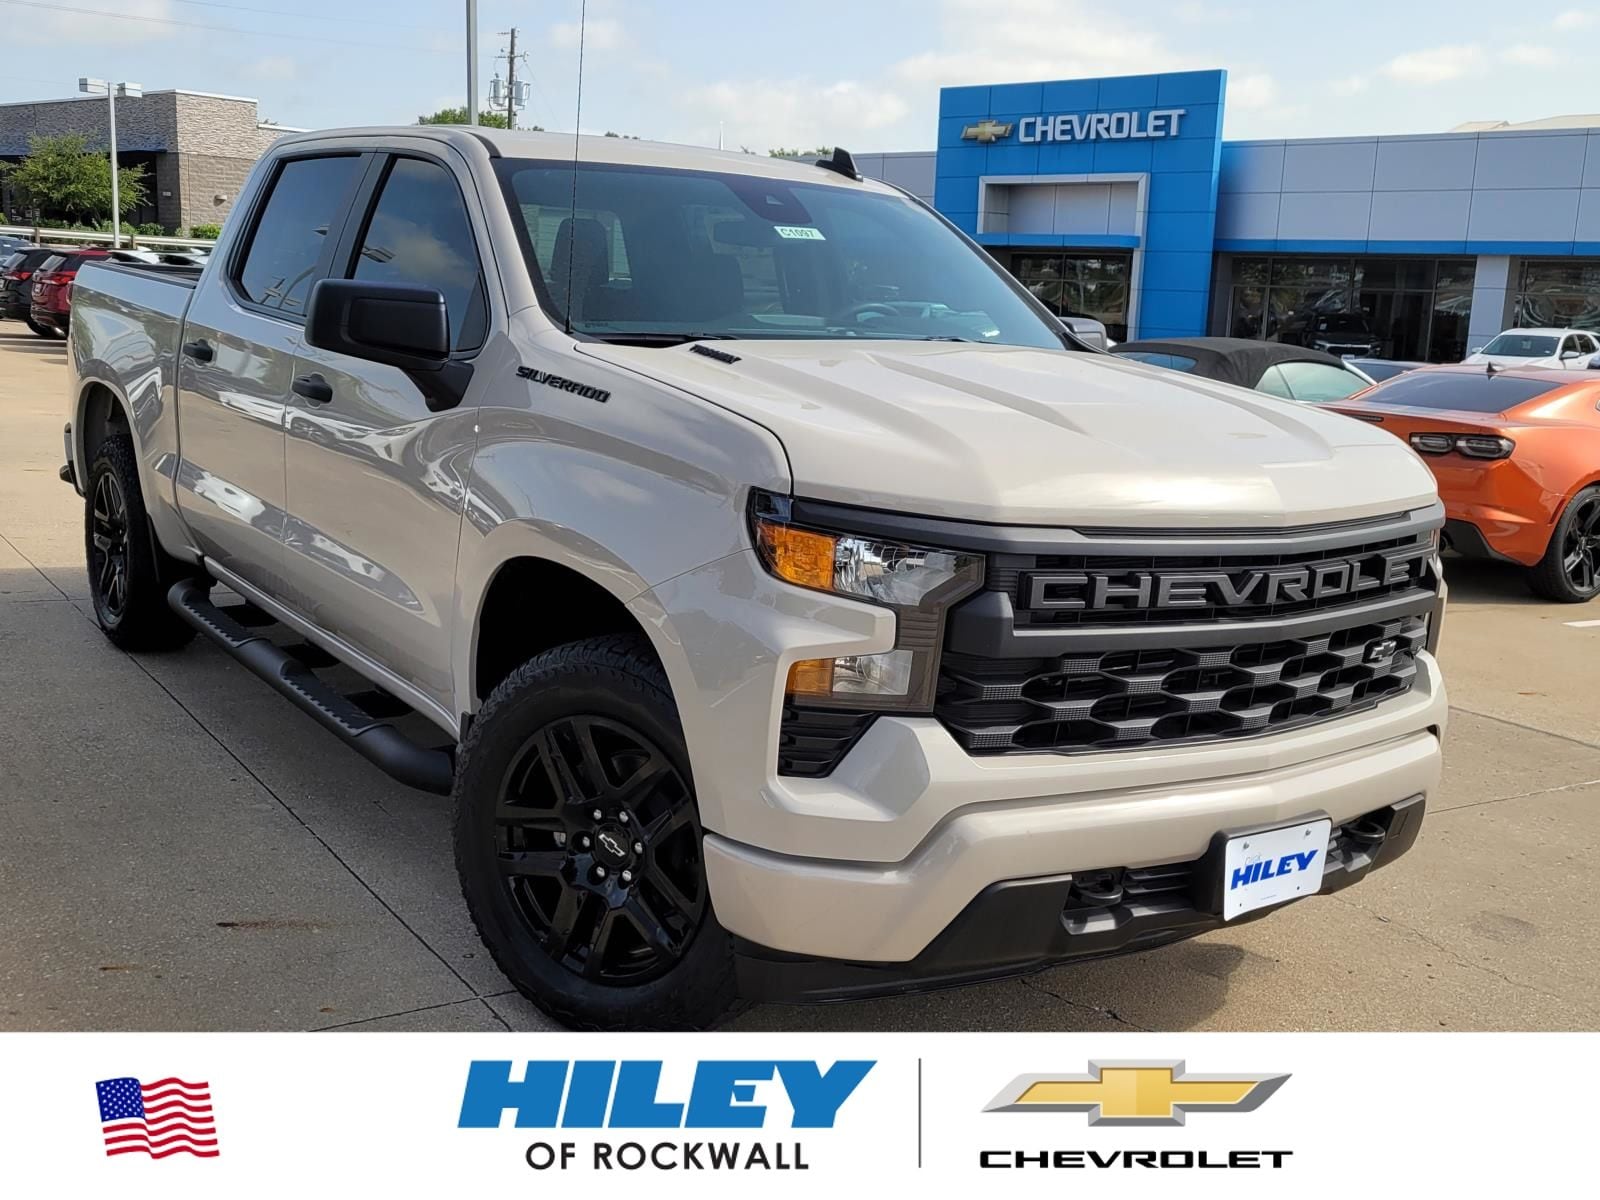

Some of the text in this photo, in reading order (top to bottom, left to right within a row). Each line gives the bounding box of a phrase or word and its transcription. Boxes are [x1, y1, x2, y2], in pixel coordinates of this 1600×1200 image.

[1019, 109, 1186, 143] CHEVROLET
[516, 365, 611, 403] SILVERADO
[1230, 849, 1318, 890] HILEY
